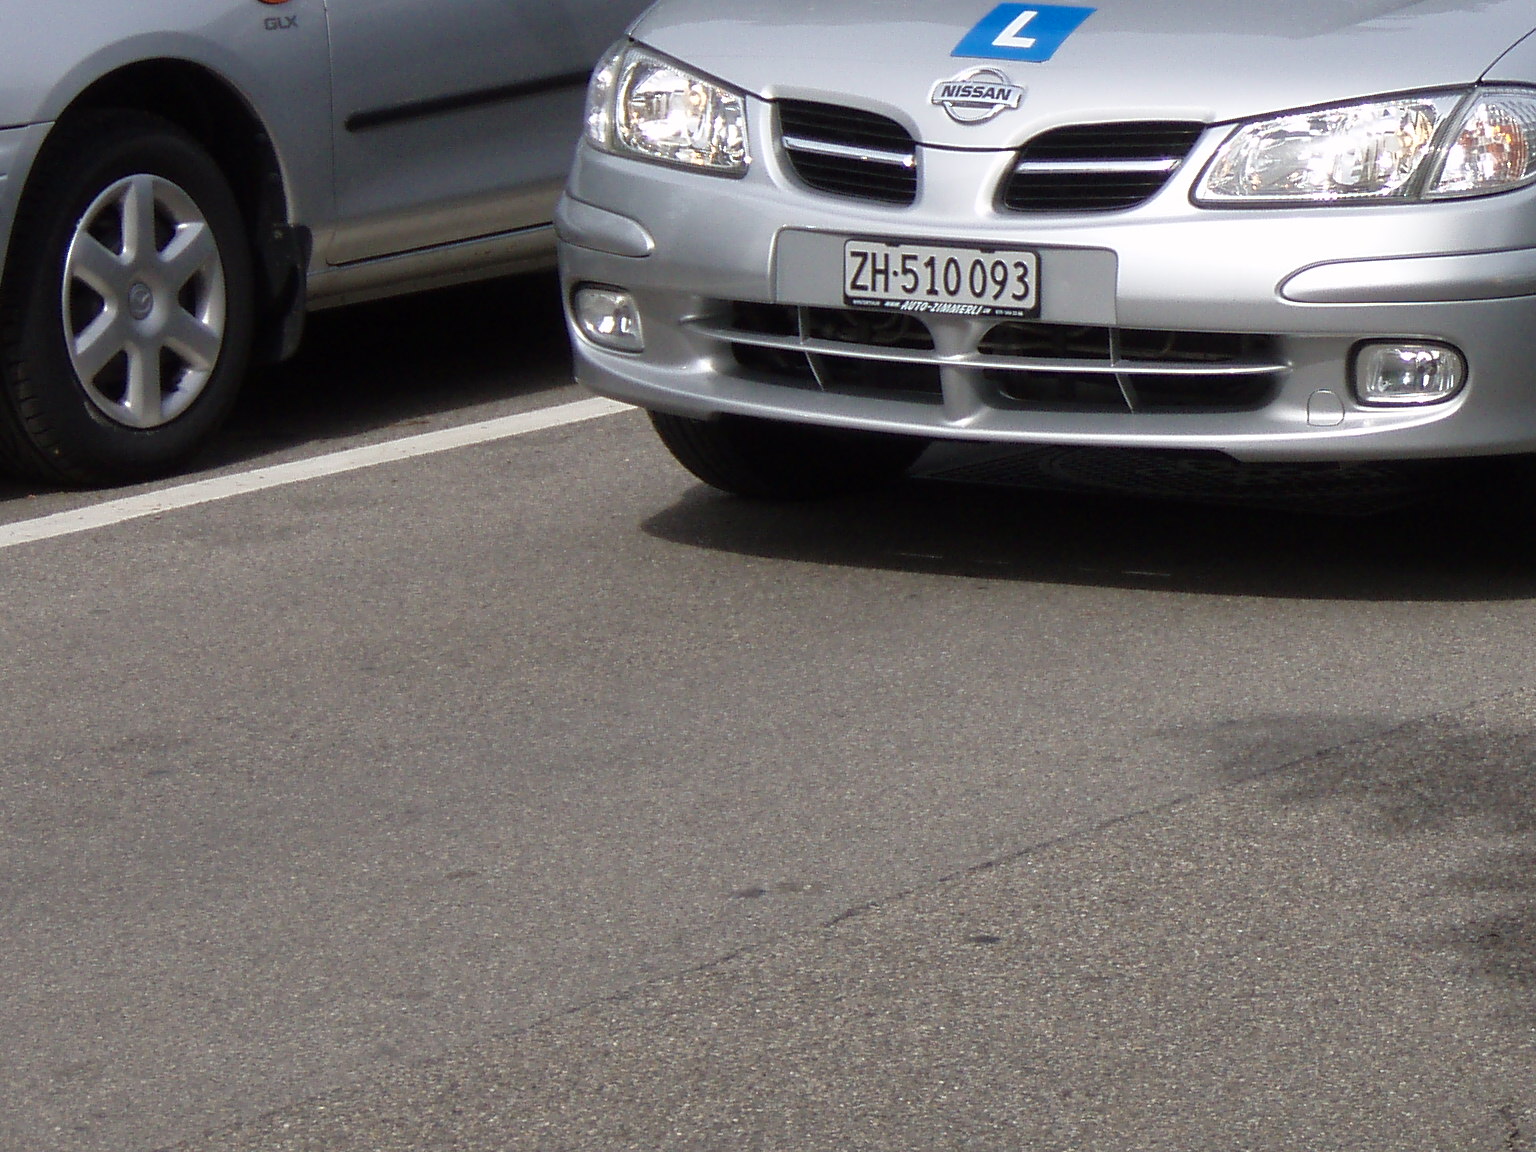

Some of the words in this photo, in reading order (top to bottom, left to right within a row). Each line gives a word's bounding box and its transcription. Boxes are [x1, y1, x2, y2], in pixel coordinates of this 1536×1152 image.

[263, 15, 299, 31] GLX
[991, 10, 1039, 48] L
[940, 85, 1012, 101] NISSAN
